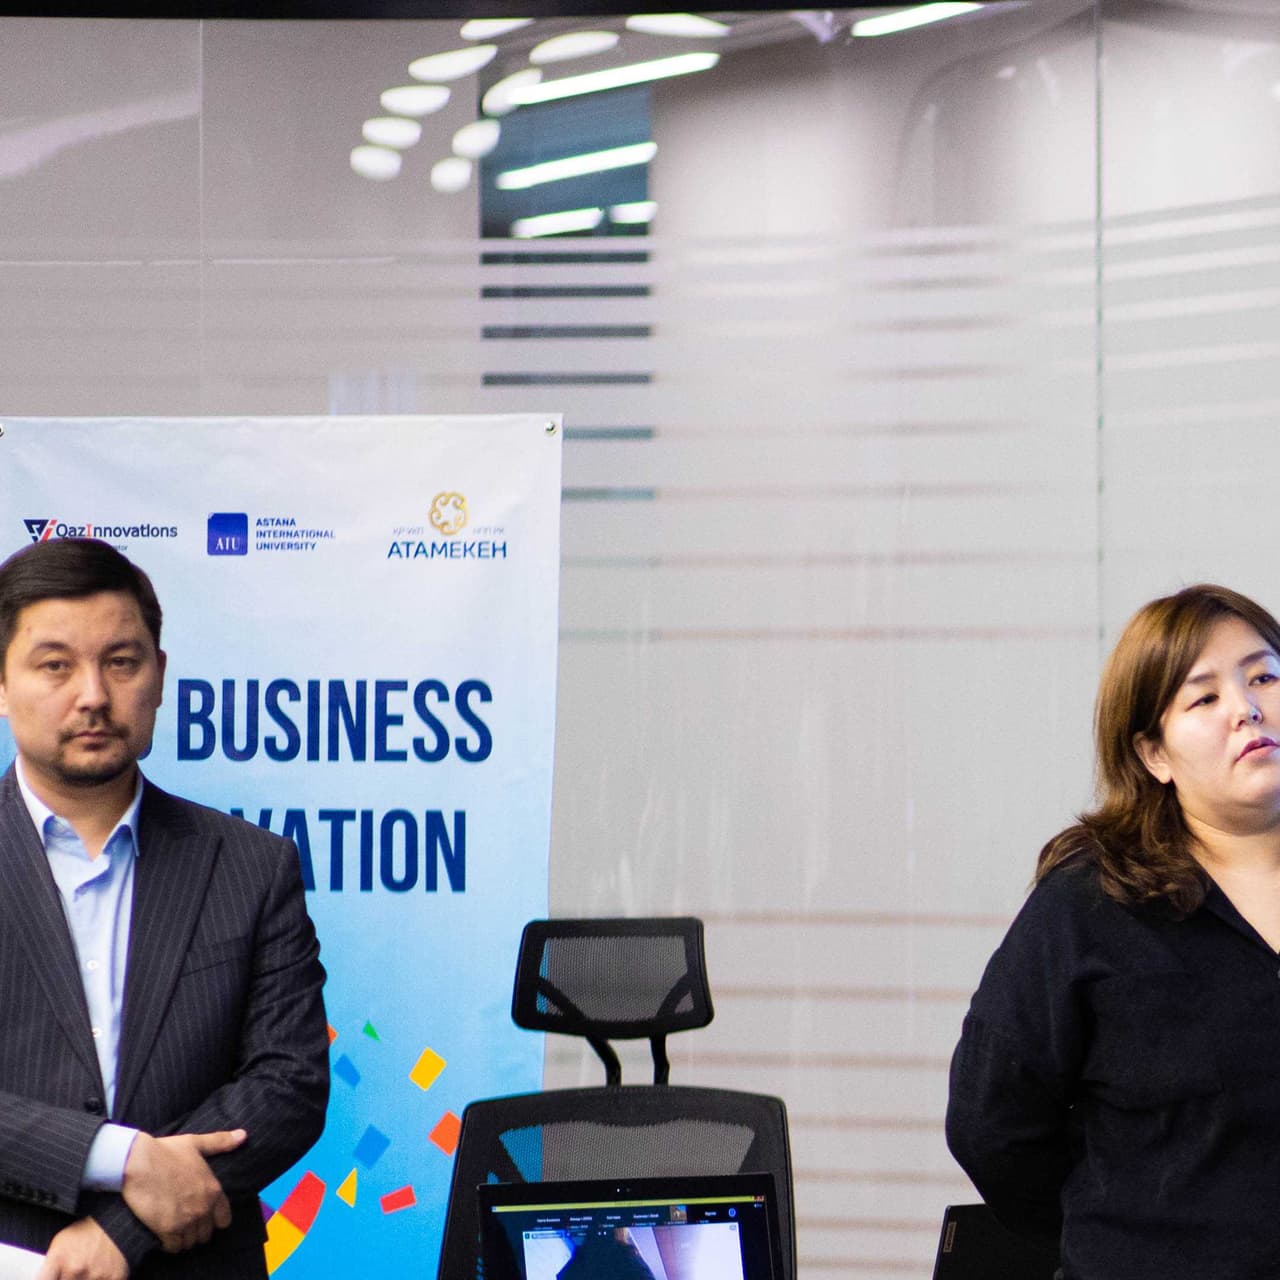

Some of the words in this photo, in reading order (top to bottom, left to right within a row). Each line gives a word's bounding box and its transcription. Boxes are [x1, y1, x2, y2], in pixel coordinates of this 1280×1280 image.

[256, 518, 296, 527] ASTANA
[56, 523, 178, 538] QazInnovations
[256, 530, 336, 539] INTERNATIONAL
[215, 536, 241, 552] AIU
[256, 542, 316, 551] UNIVERSITY
[177, 678, 493, 762] BUSINESS
